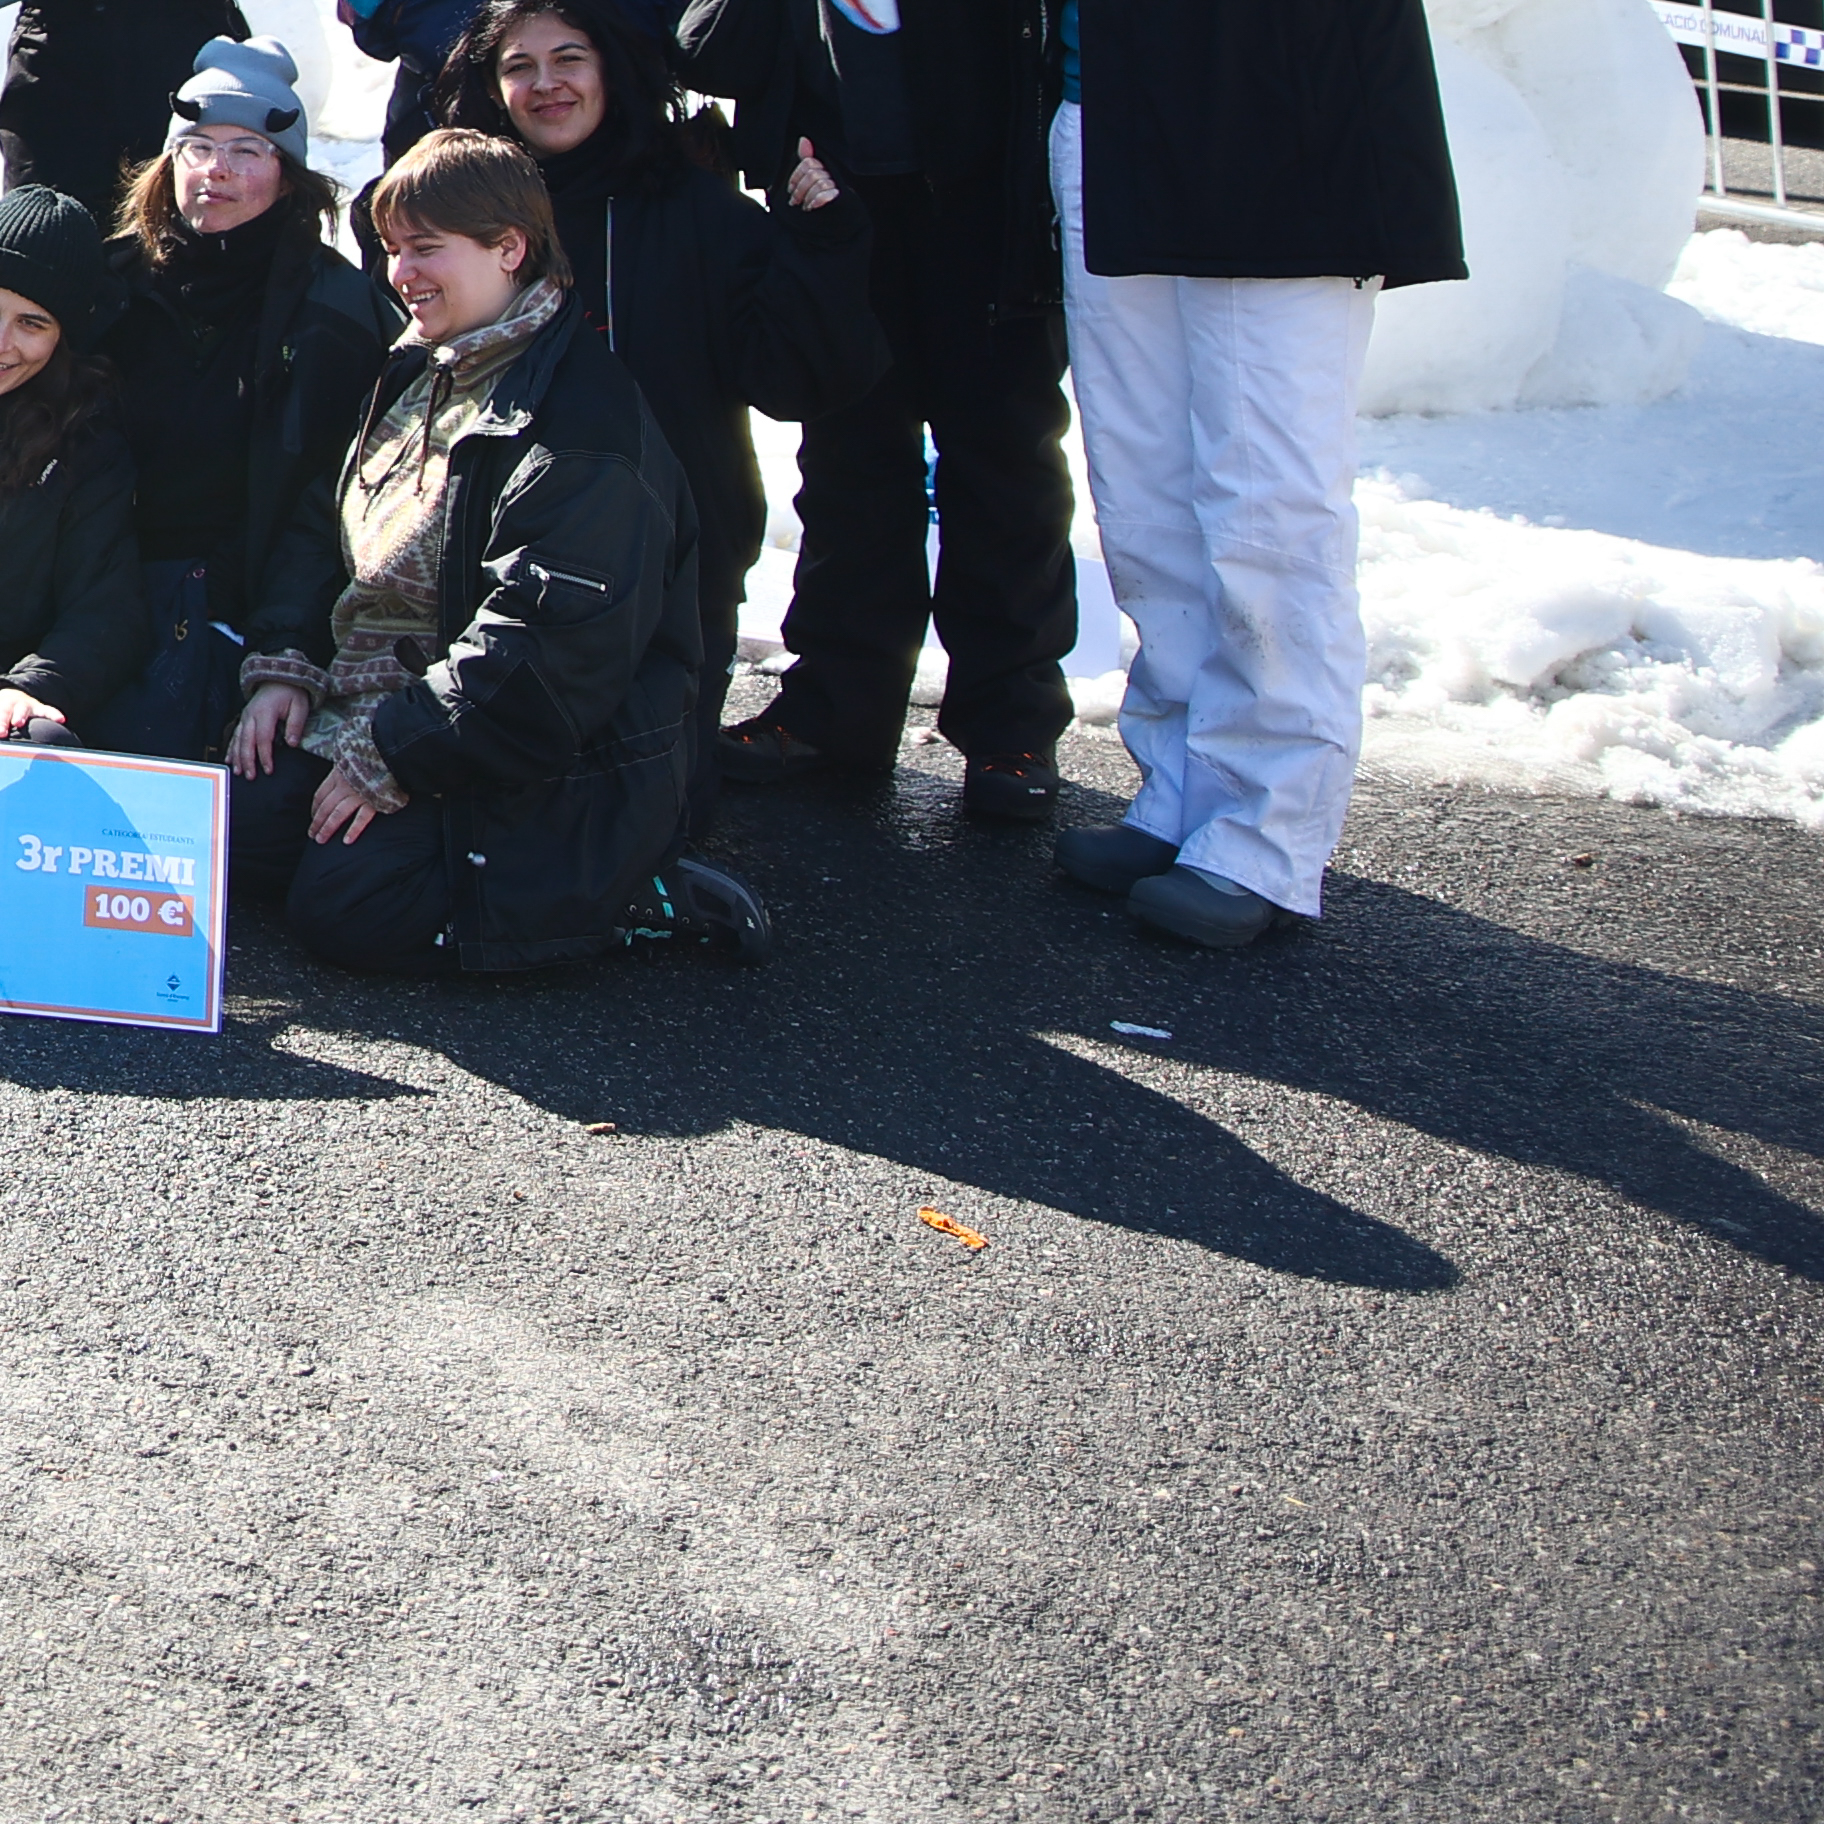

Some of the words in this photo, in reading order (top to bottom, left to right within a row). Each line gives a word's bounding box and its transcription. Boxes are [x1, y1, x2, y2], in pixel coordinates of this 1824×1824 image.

[101, 828, 148, 840] CATEGORIA
[148, 832, 196, 845] ESTUDIANTS
[14, 834, 63, 873] 3r
[68, 847, 196, 887] PREMI
[94, 892, 150, 922] 100
[156, 900, 185, 926] €
